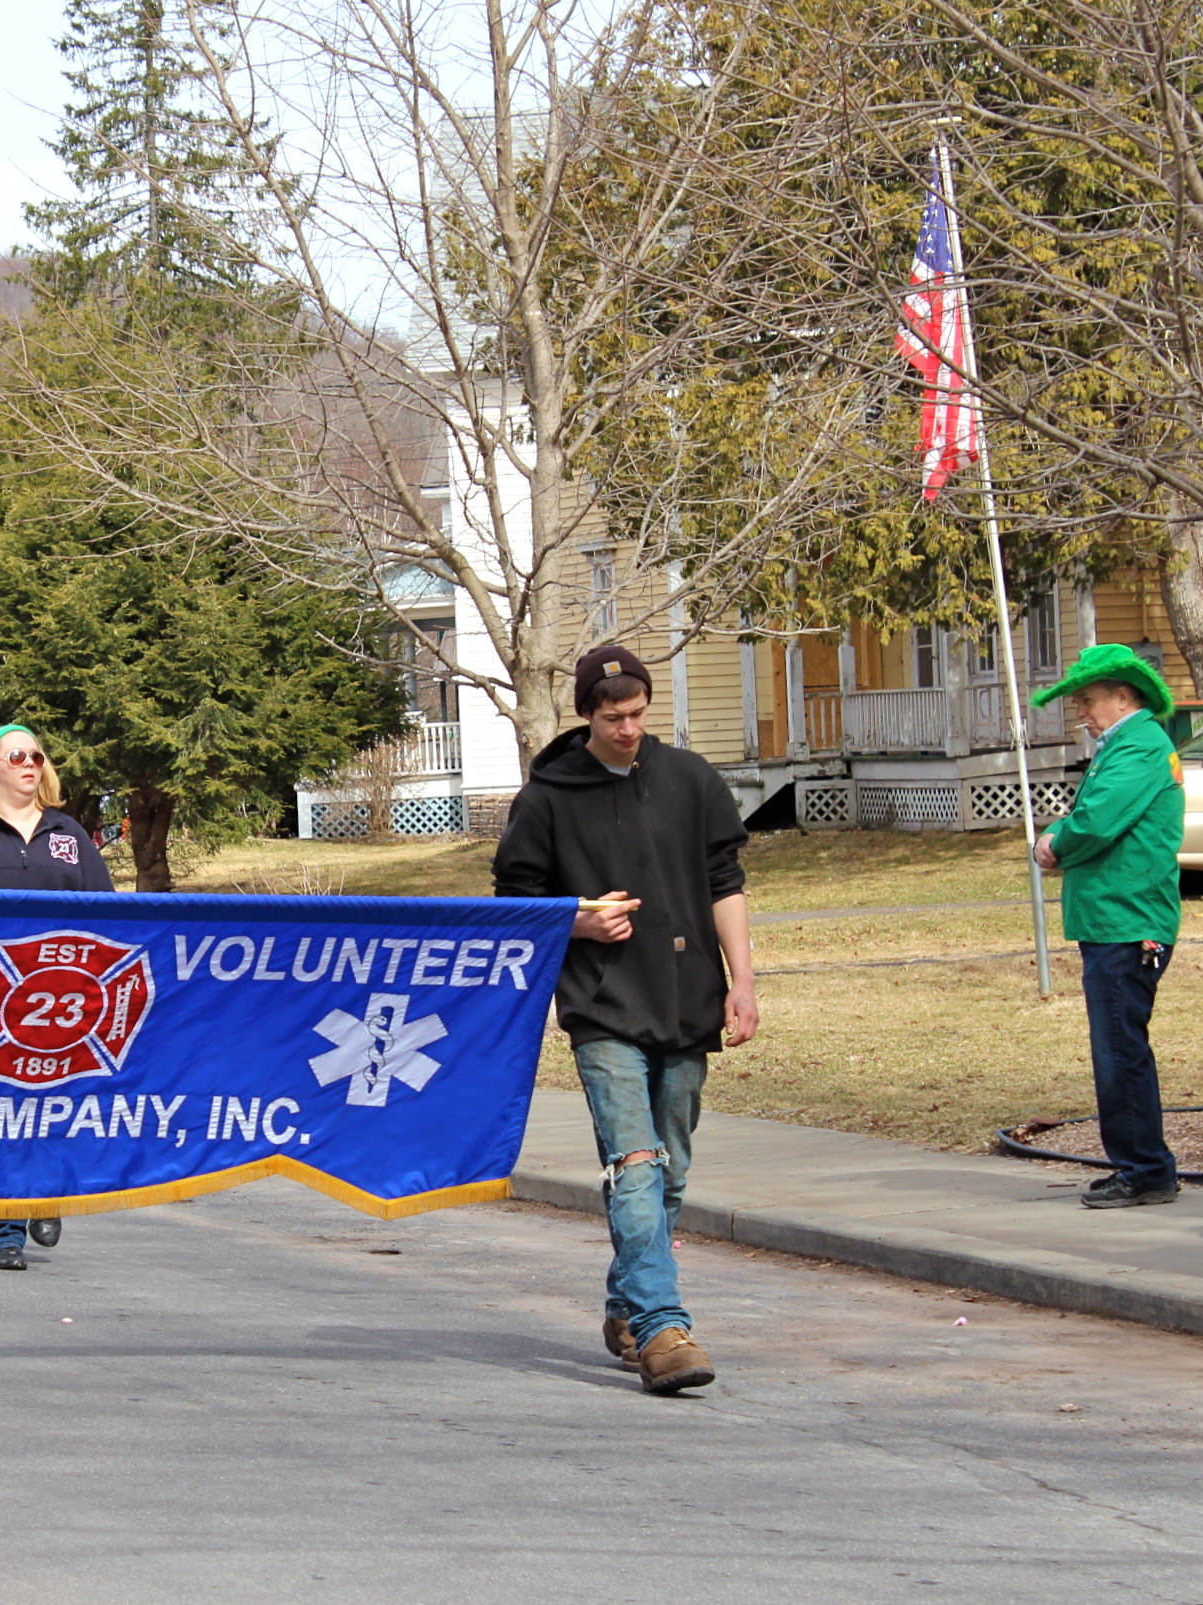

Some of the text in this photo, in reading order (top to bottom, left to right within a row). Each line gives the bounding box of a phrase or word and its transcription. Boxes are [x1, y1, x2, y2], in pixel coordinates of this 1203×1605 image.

[58, 843, 69, 854] 23
[37, 943, 96, 964] EST
[174, 934, 535, 990] VOLUNTEER
[20, 992, 86, 1029] 23
[12, 1056, 72, 1076] 1891
[206, 1095, 311, 1145] INC.
